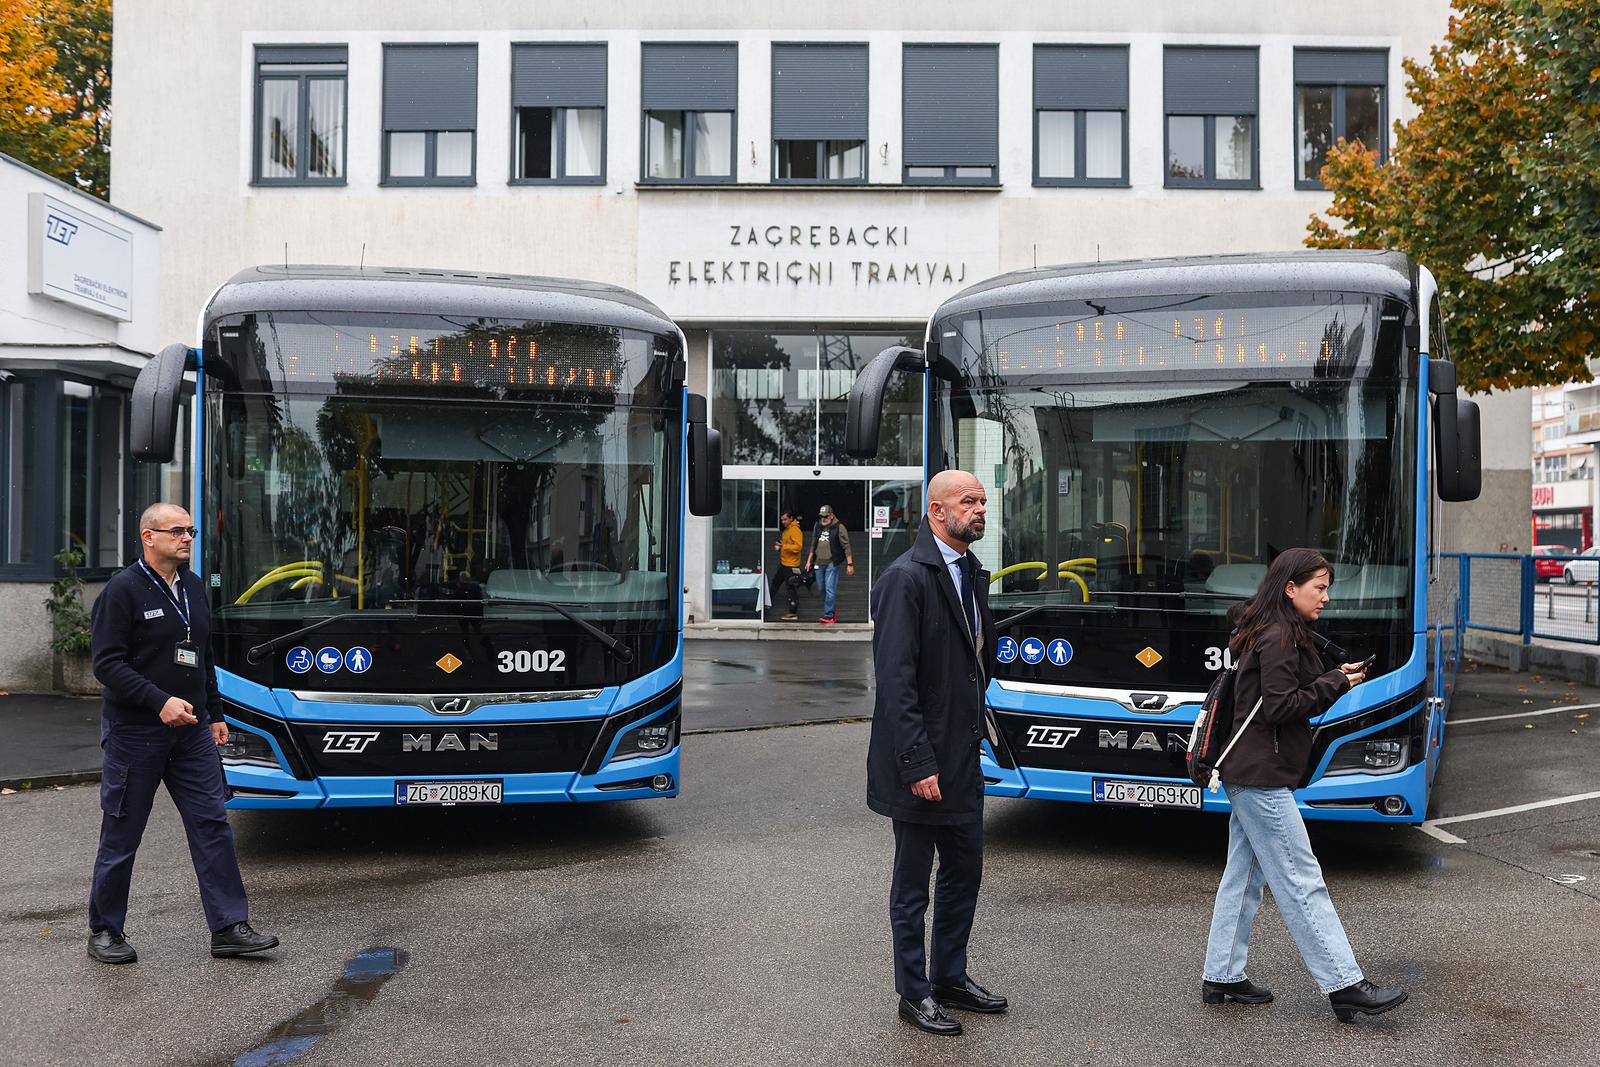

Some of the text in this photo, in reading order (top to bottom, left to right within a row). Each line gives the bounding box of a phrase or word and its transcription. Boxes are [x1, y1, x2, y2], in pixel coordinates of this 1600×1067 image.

[497, 649, 566, 673] 3002
[322, 731, 381, 754] ZET
[402, 732, 498, 752] MAN
[1026, 725, 1082, 749] ZET
[1098, 729, 1191, 752] MAN
[409, 786, 428, 801] ZG
[1106, 784, 1125, 801] ZG
